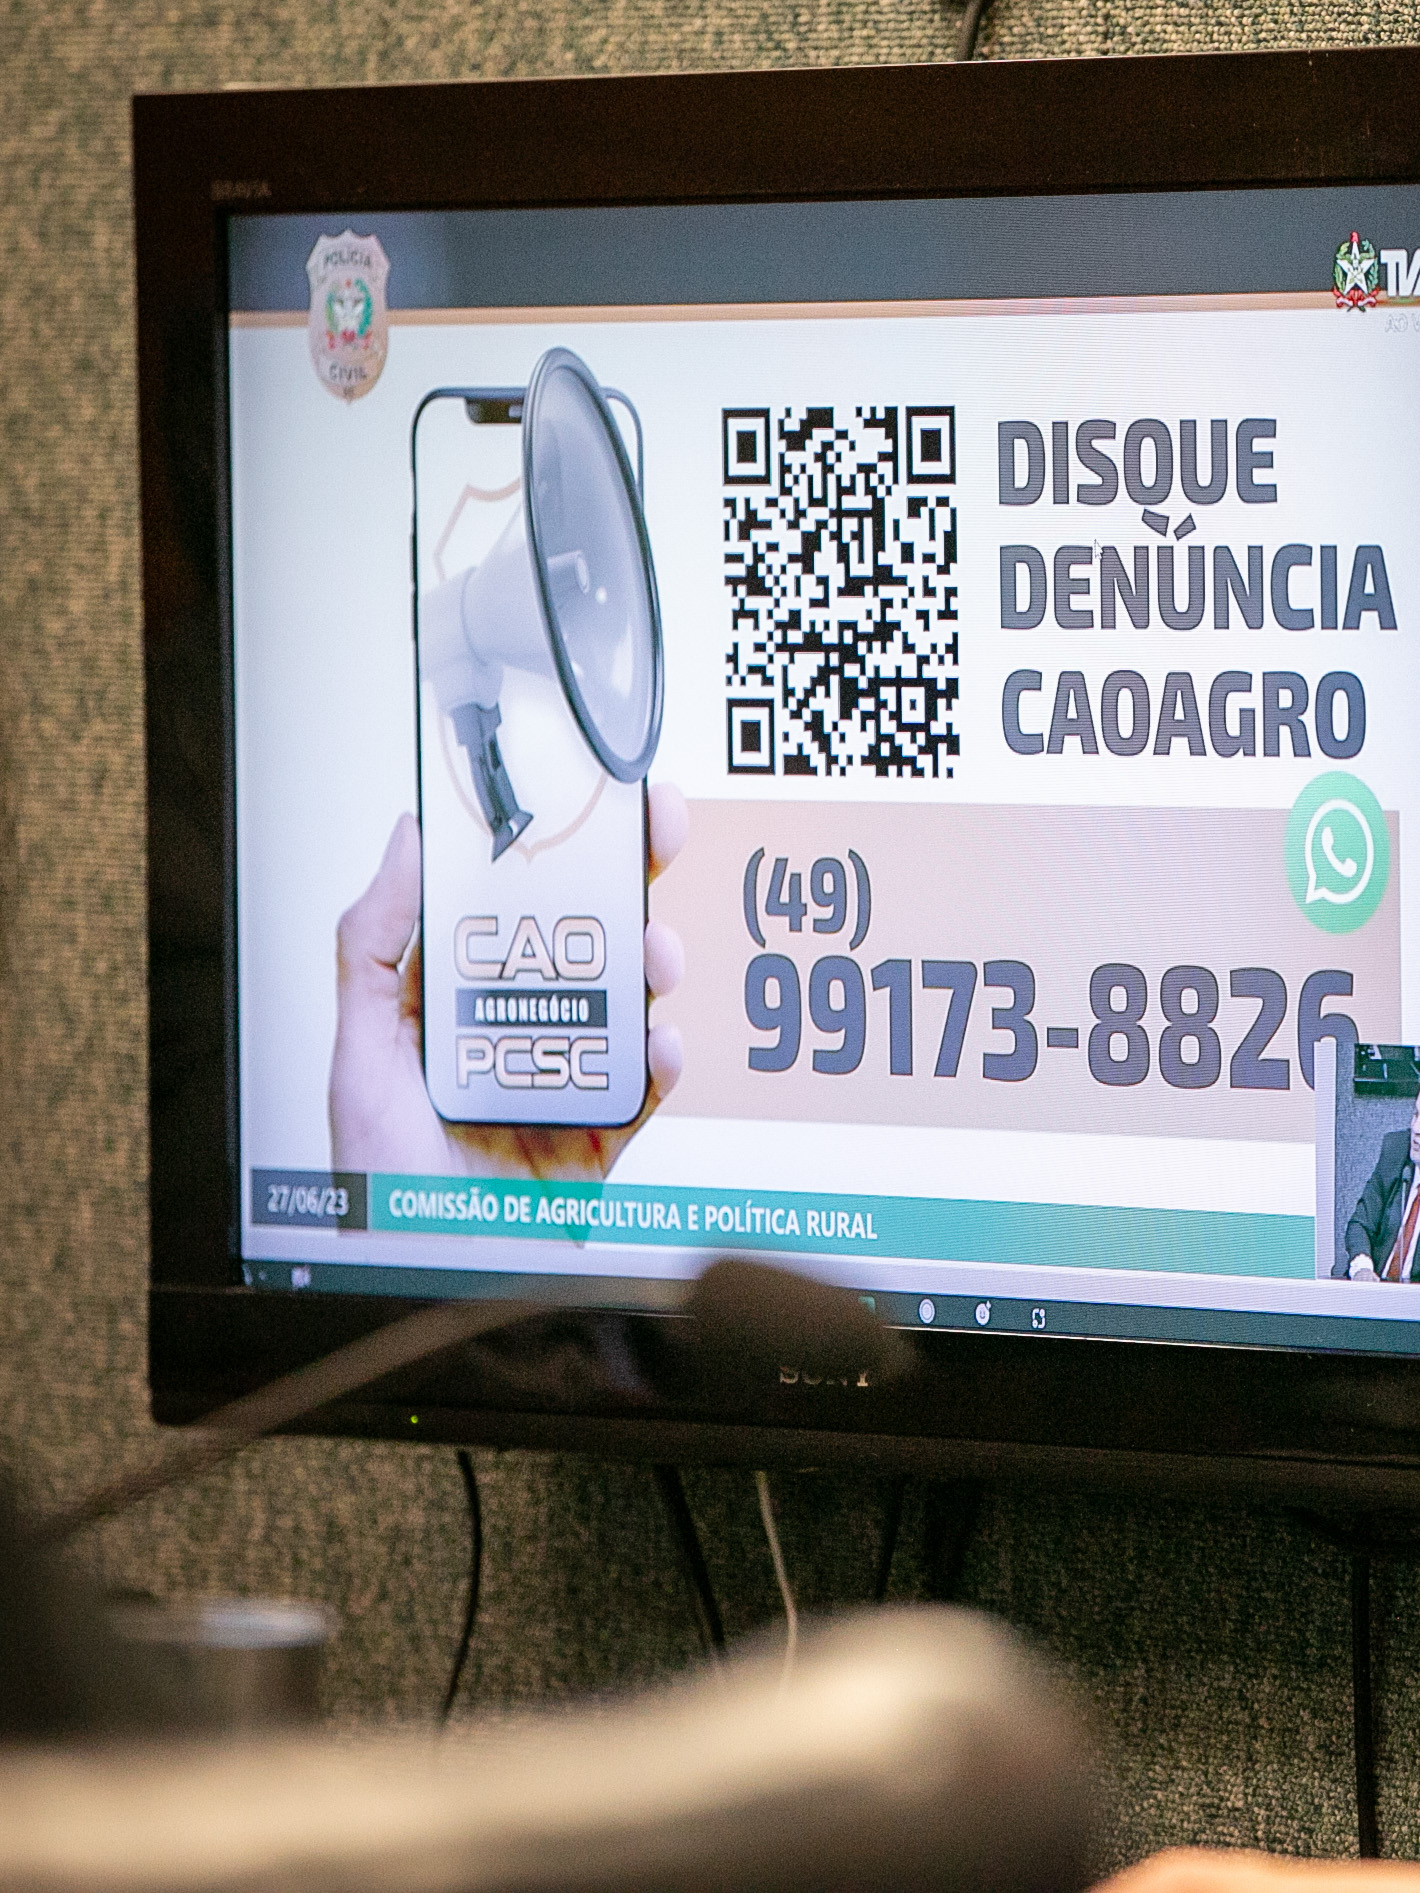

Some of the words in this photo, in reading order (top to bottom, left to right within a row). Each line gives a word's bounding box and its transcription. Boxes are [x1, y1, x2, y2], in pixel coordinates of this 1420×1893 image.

[999, 418, 1278, 536] DISQUE
[999, 513, 1398, 632] DENÚNCIA
[1001, 669, 1368, 759] CAOAGRO
[743, 847, 872, 950] (49)
[454, 915, 607, 982] CAO
[474, 993, 590, 1023] AGRONEGÓCIO
[744, 953, 1360, 1092] 99173-8826
[455, 1034, 609, 1090] PCSC
[267, 1184, 349, 1216] 27/06/23
[388, 1186, 500, 1222] COMISSÃO
[503, 1194, 531, 1224] DE
[535, 1197, 682, 1231] AGRICULTURA
[686, 1204, 699, 1231] E
[704, 1199, 801, 1236] POLÍTICA
[806, 1209, 878, 1240] RURAL
